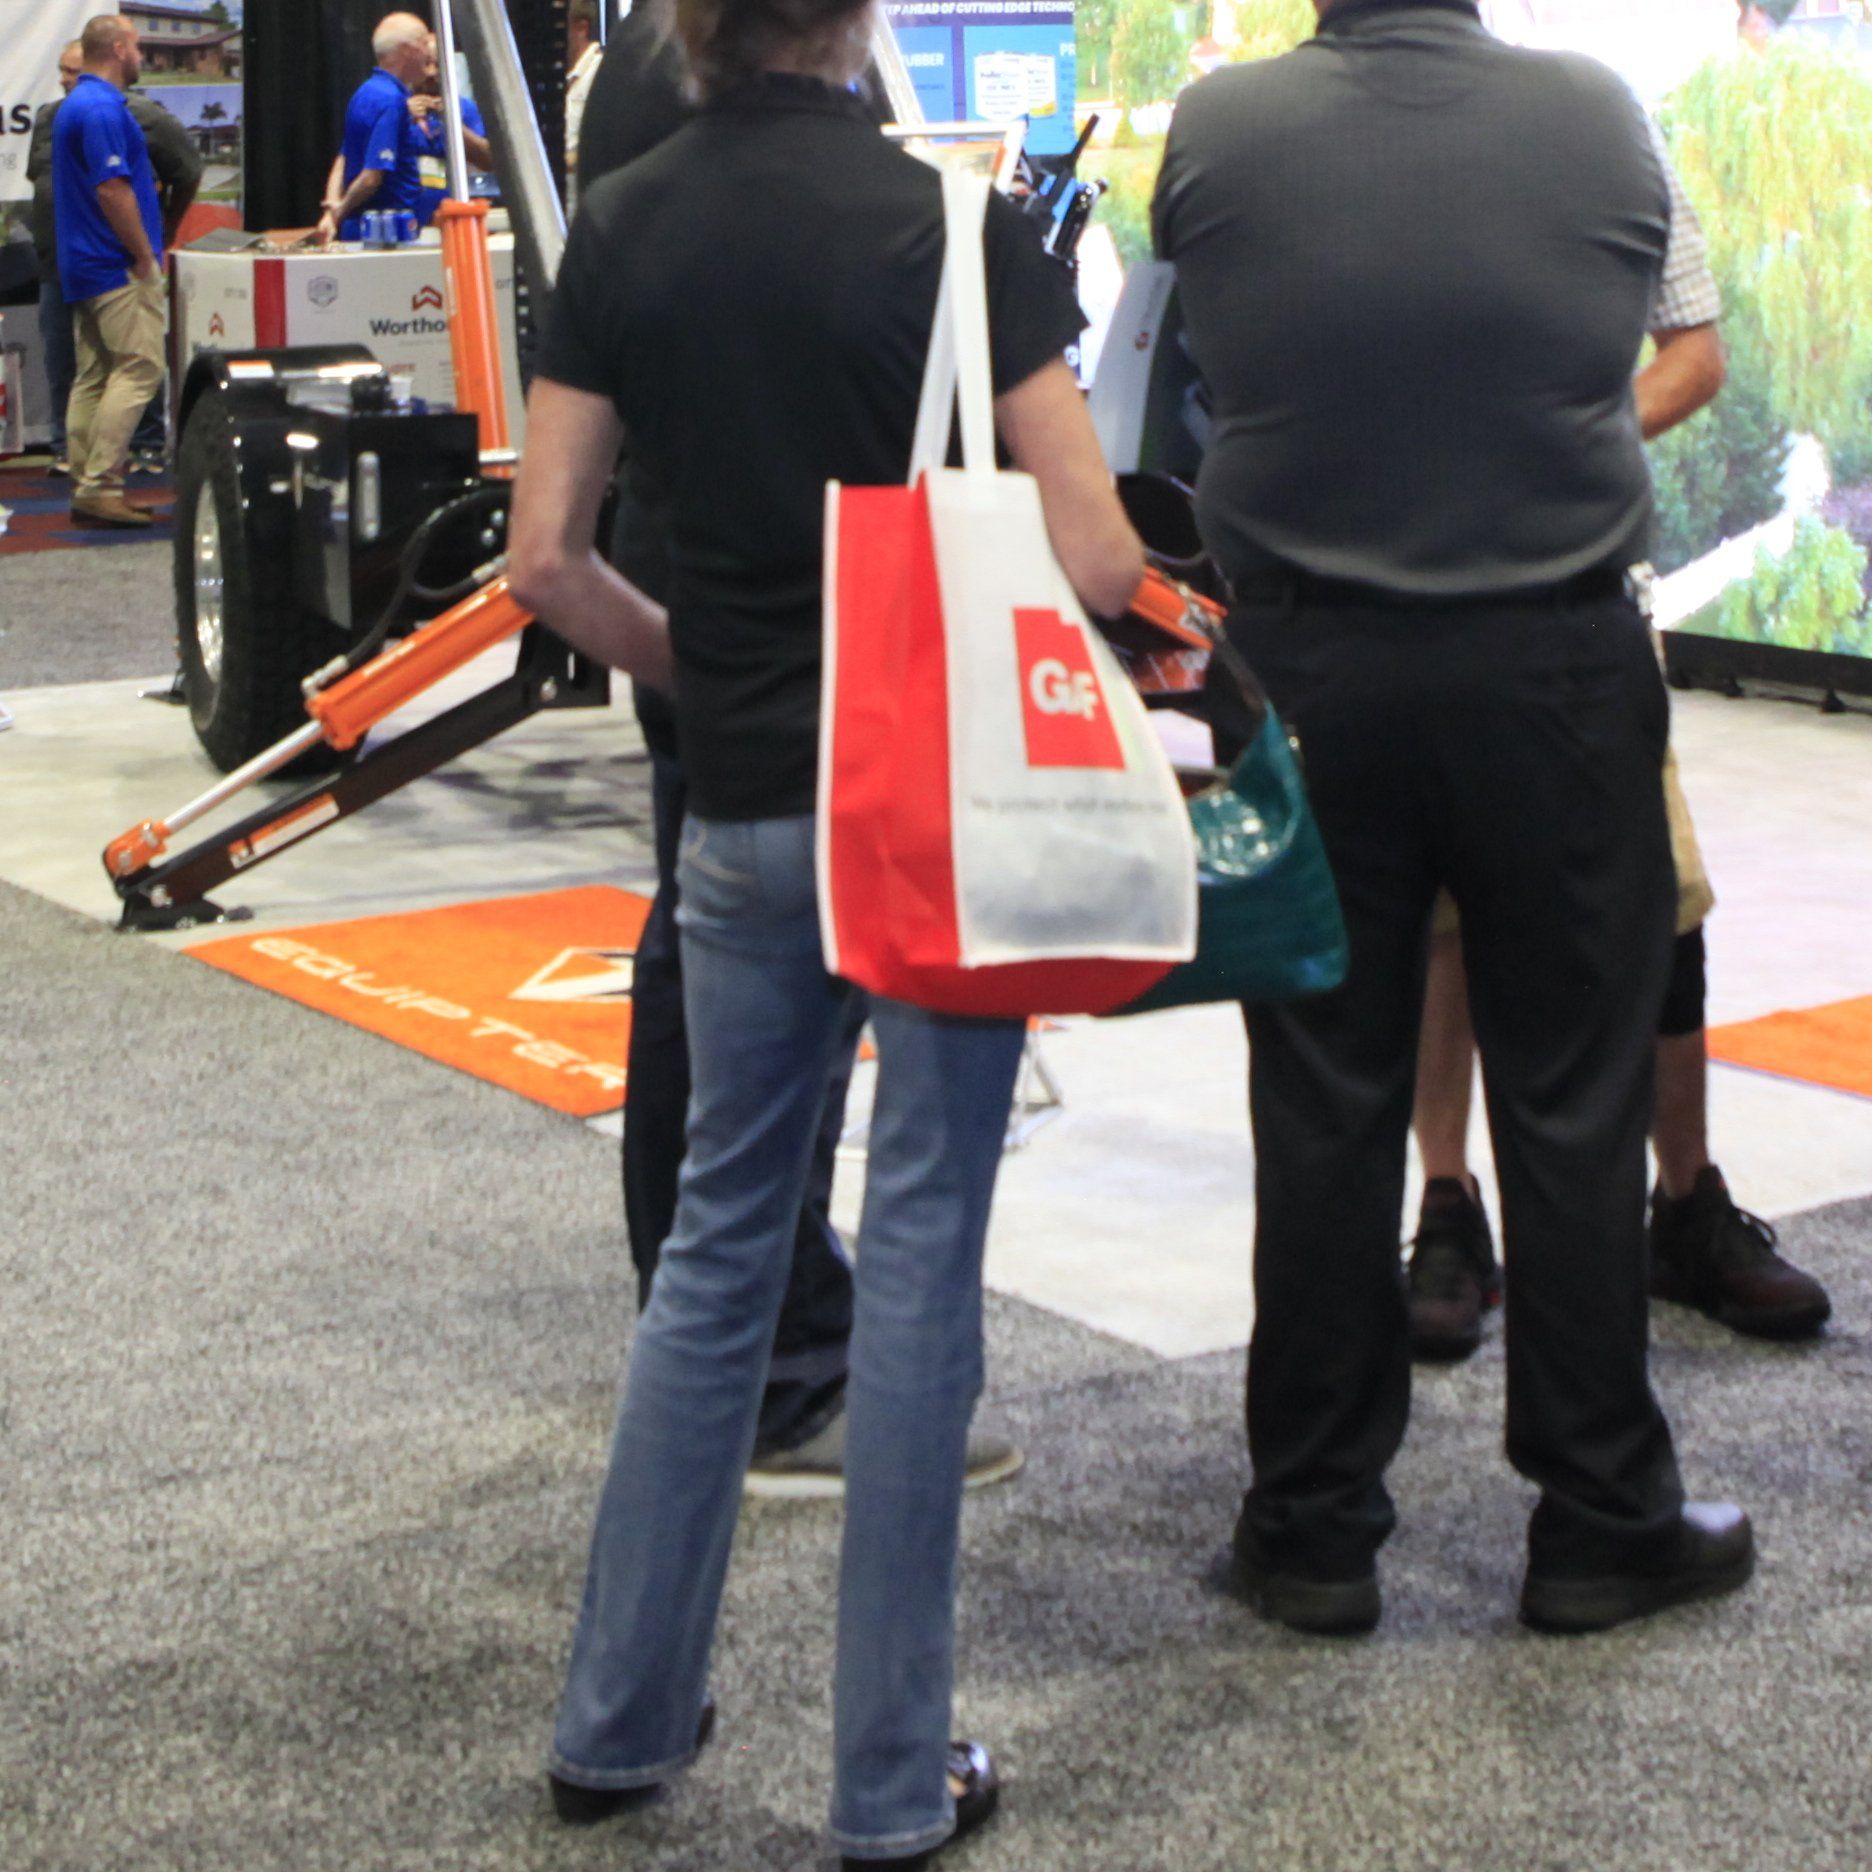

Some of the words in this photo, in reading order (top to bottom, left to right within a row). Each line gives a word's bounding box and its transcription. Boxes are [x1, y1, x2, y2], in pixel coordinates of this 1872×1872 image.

[941, 3, 955, 14] OF
[956, 2, 1003, 14] CUTTING
[1032, 1, 1075, 13] TECHNO
[905, 53, 945, 67] UBBER
[369, 317, 446, 336] Wortho
